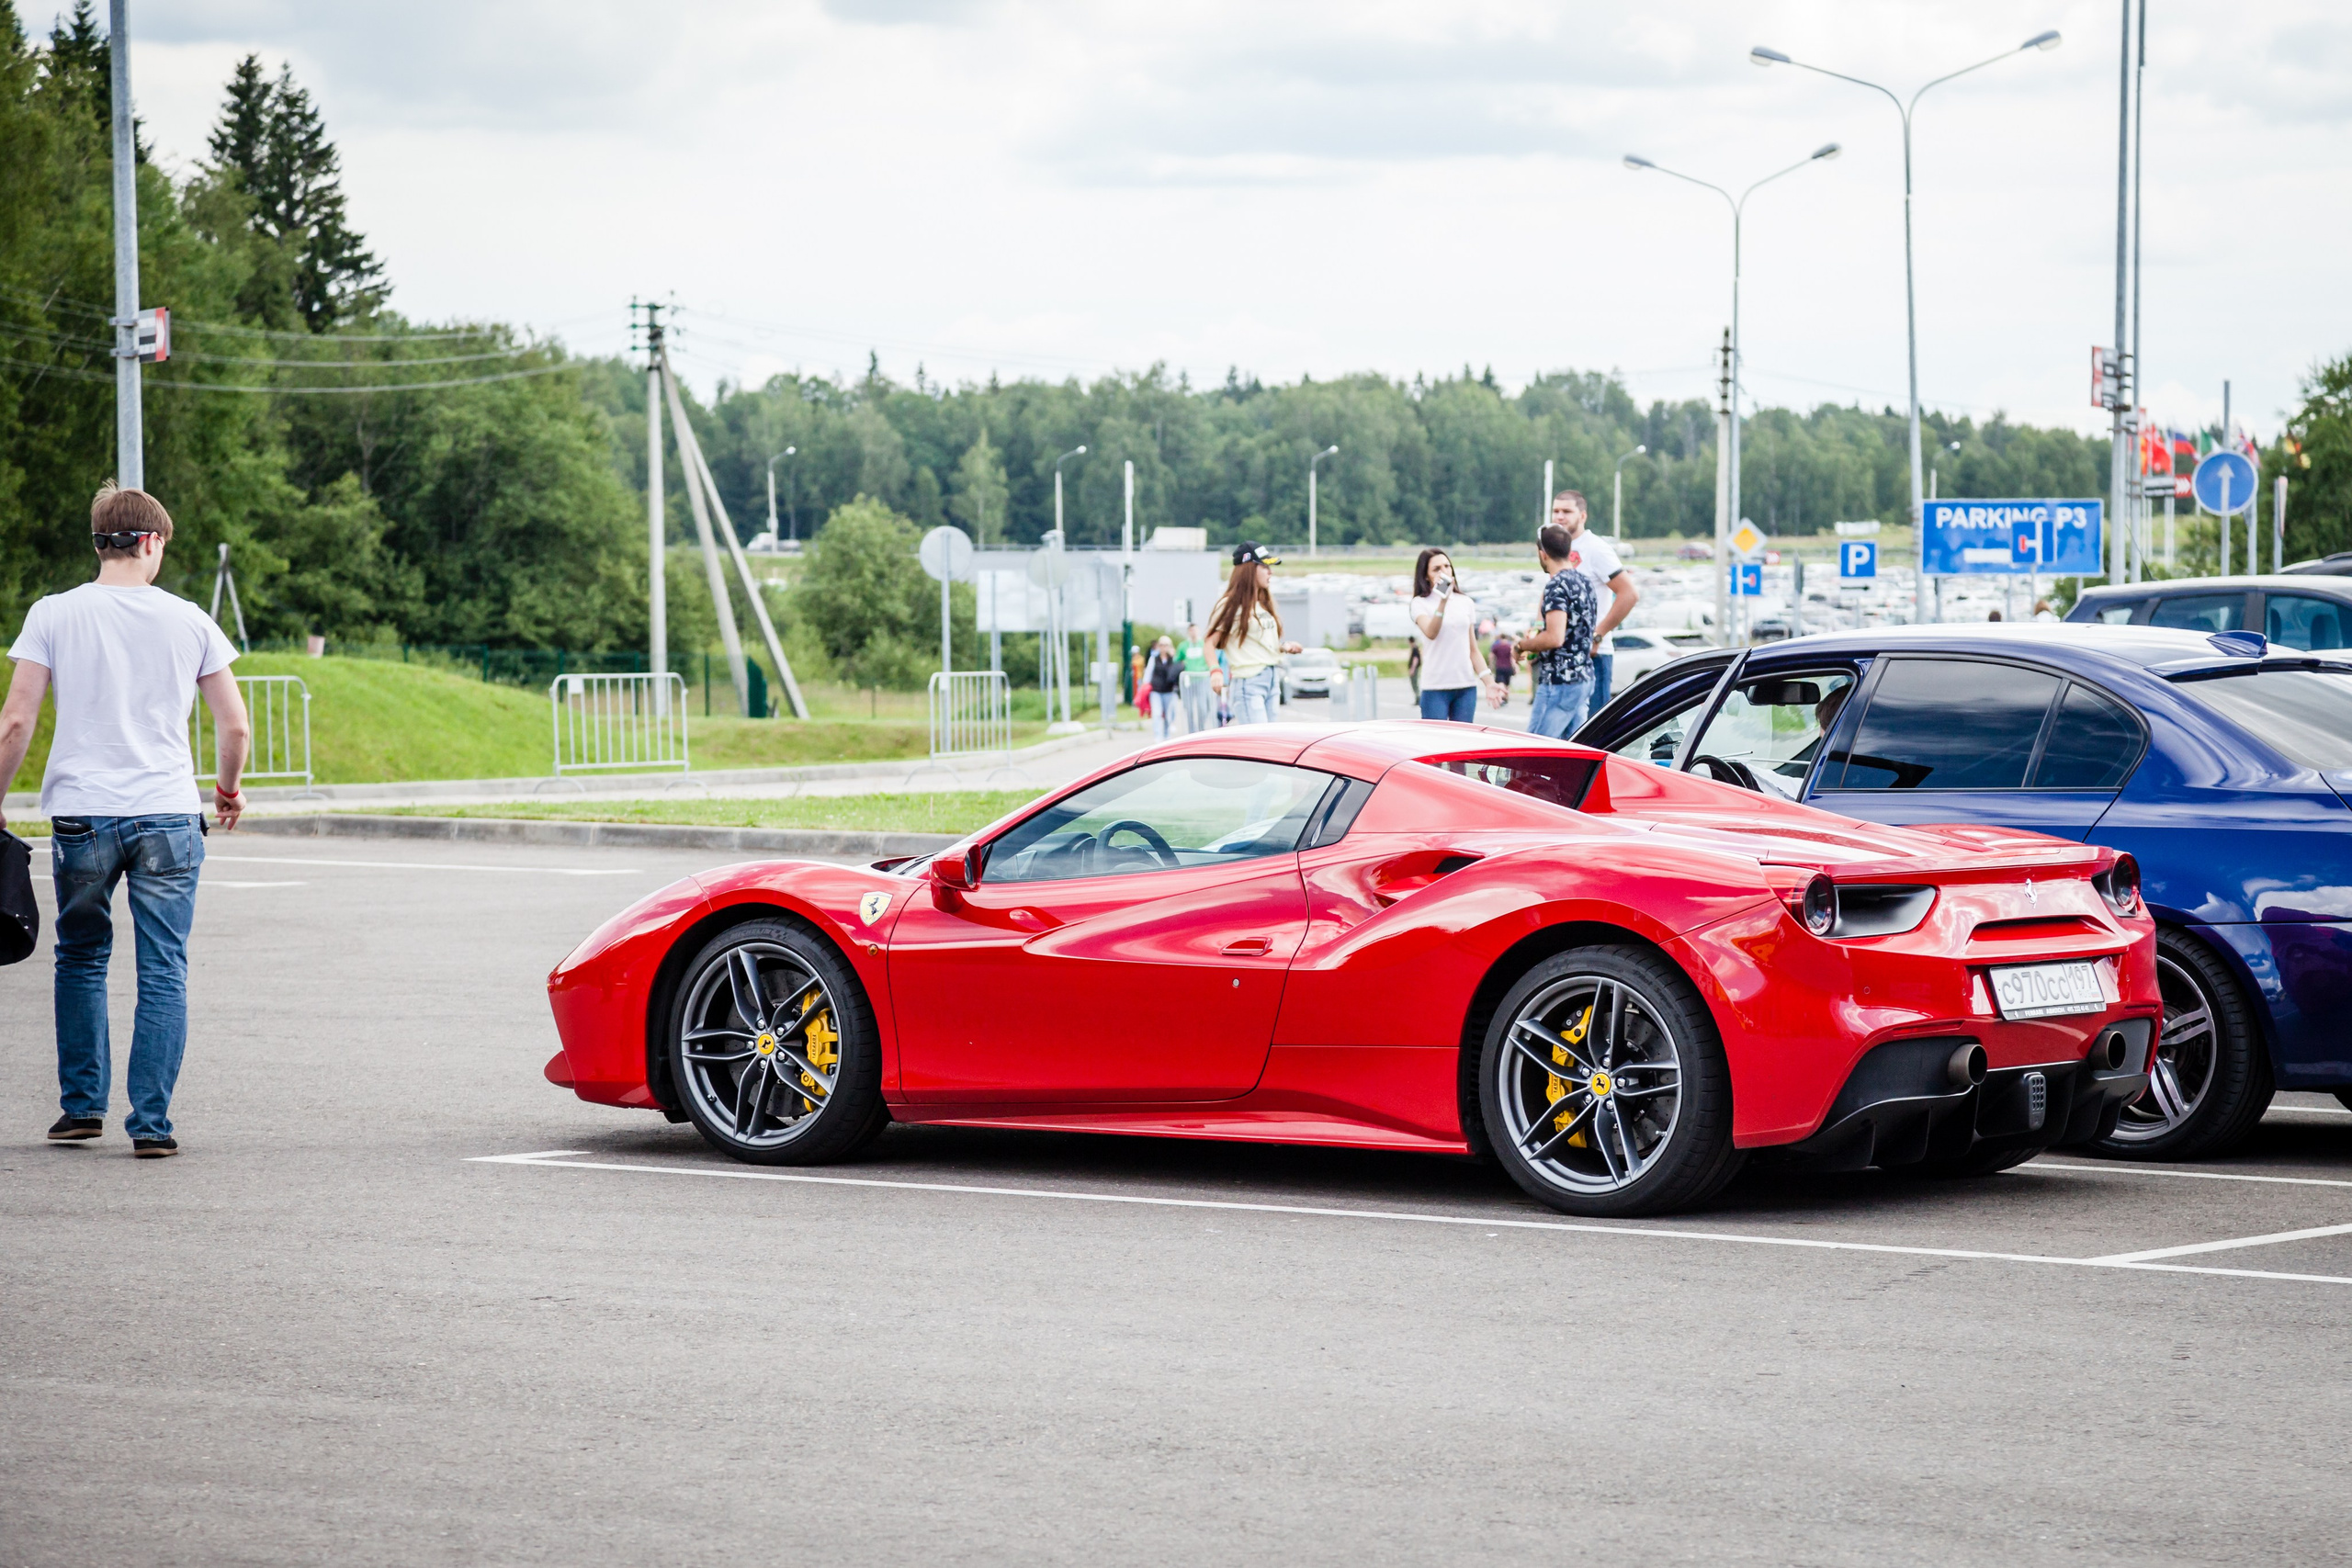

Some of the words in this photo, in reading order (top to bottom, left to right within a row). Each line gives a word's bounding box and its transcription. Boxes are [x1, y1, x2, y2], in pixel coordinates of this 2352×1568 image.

[1936, 506, 2049, 529] PARKING
[2056, 506, 2087, 530] P3
[1847, 544, 1871, 576] P
[2068, 964, 2092, 989] 197
